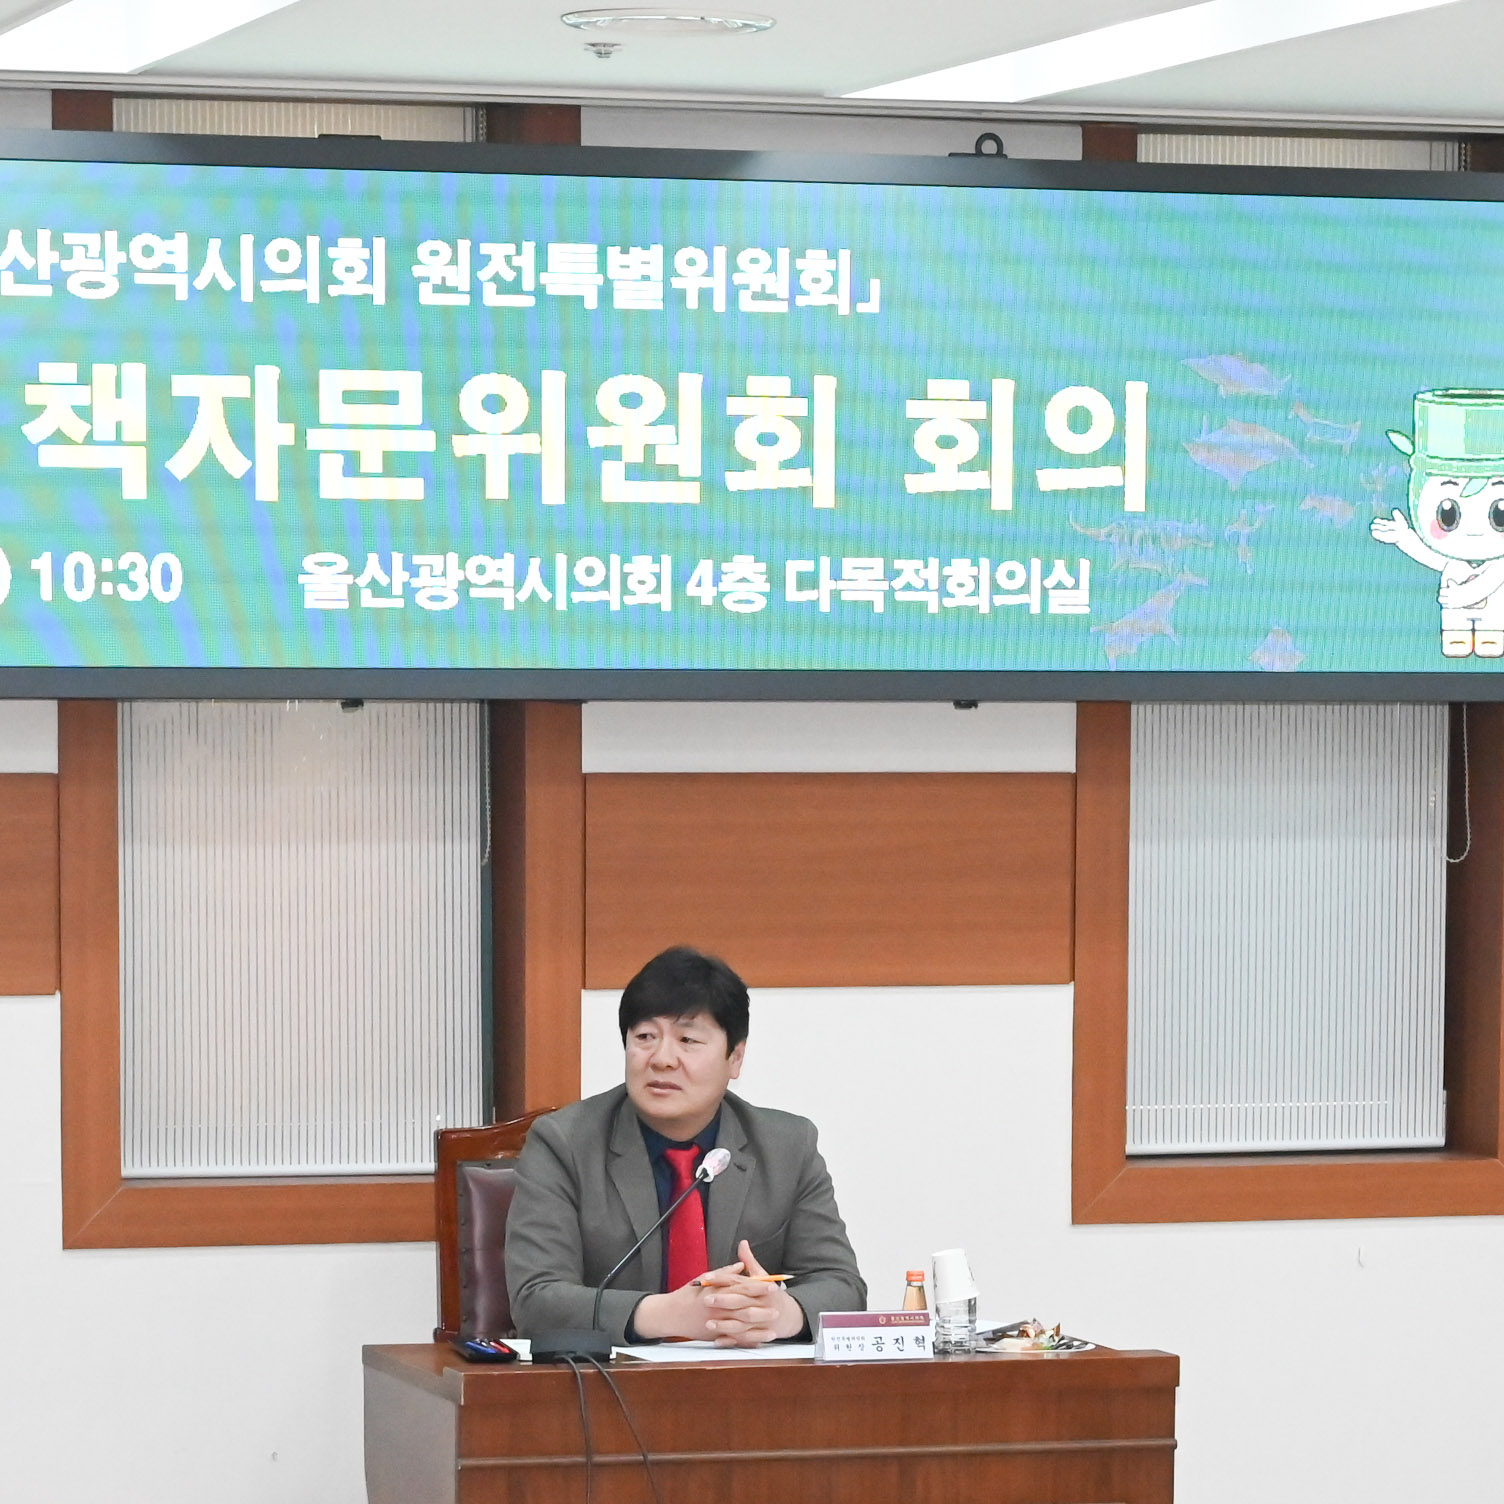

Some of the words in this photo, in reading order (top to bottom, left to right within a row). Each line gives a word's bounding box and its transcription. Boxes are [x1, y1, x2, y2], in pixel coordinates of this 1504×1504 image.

[902, 378, 1149, 512] 회의
[30, 550, 184, 604] 10:30
[297, 550, 673, 612] 울산광역시의회
[685, 554, 771, 614] 4층
[784, 555, 1092, 615] 다목적회의실
